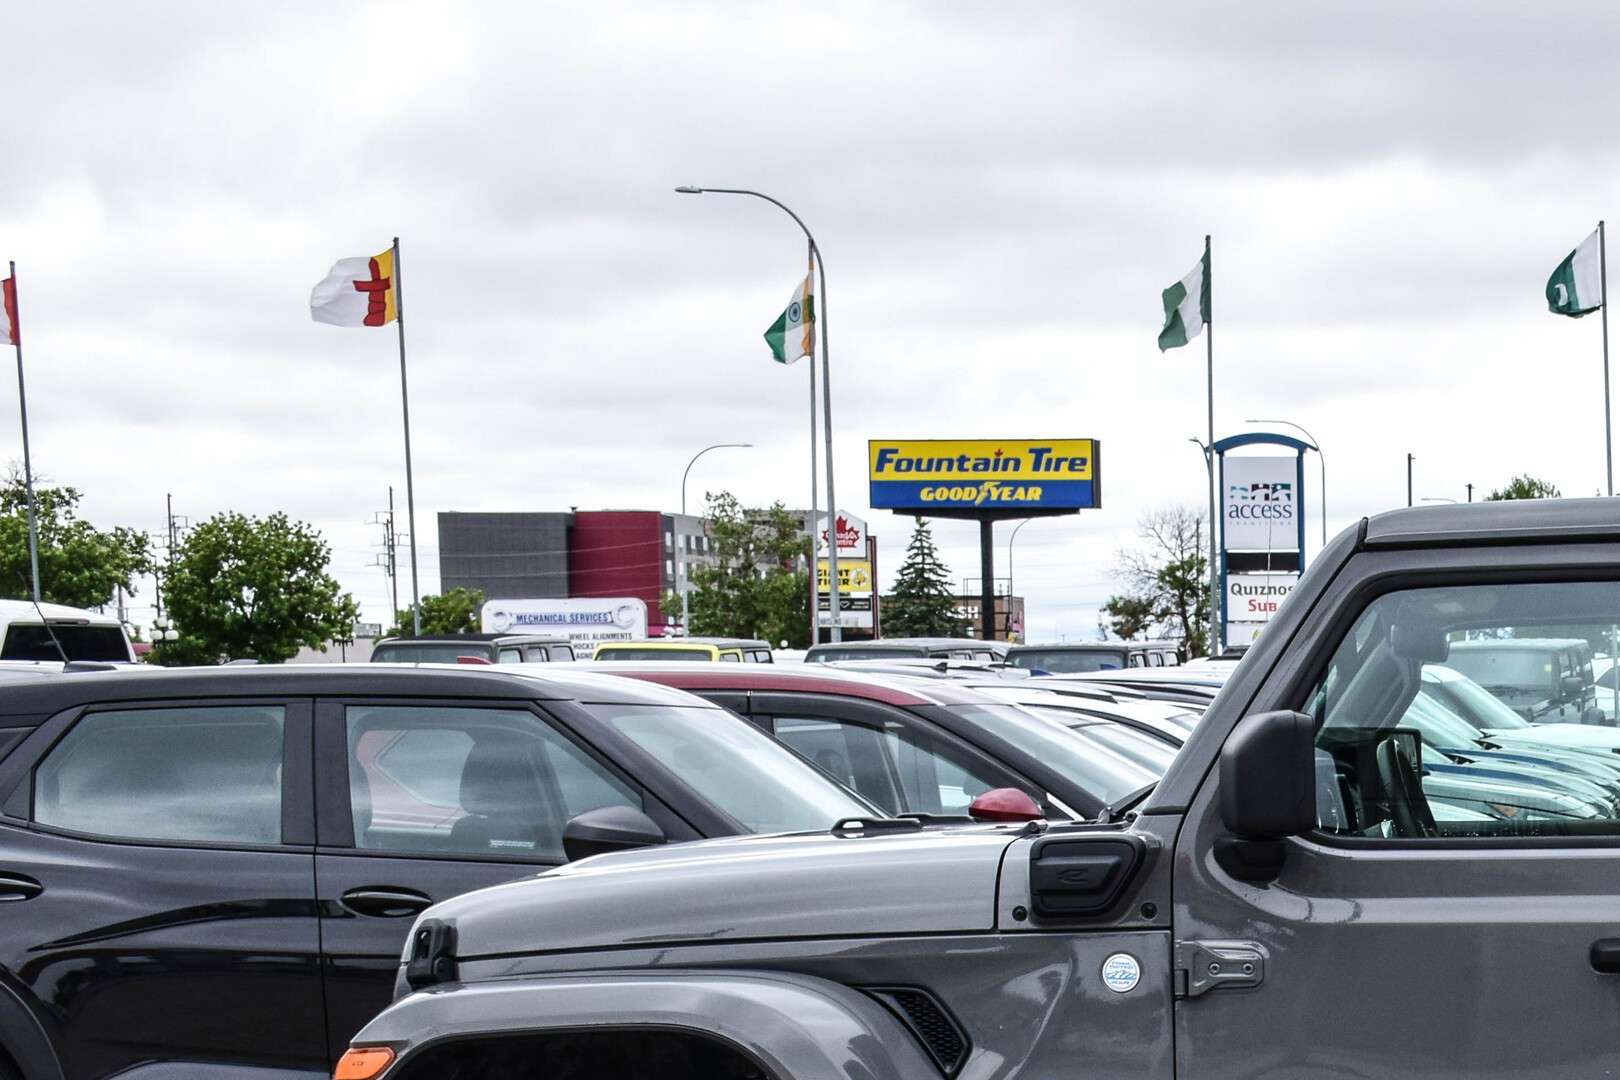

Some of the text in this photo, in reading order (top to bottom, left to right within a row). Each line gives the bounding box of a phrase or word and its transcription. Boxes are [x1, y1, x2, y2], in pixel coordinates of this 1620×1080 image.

[875, 447, 1088, 473] Fountain Tire
[920, 484, 1042, 503] GOODYEAR
[1228, 504, 1292, 519] access
[817, 569, 849, 577] GINT
[817, 578, 849, 586] TIER
[516, 612, 609, 624] MECHANICAL SERVICES
